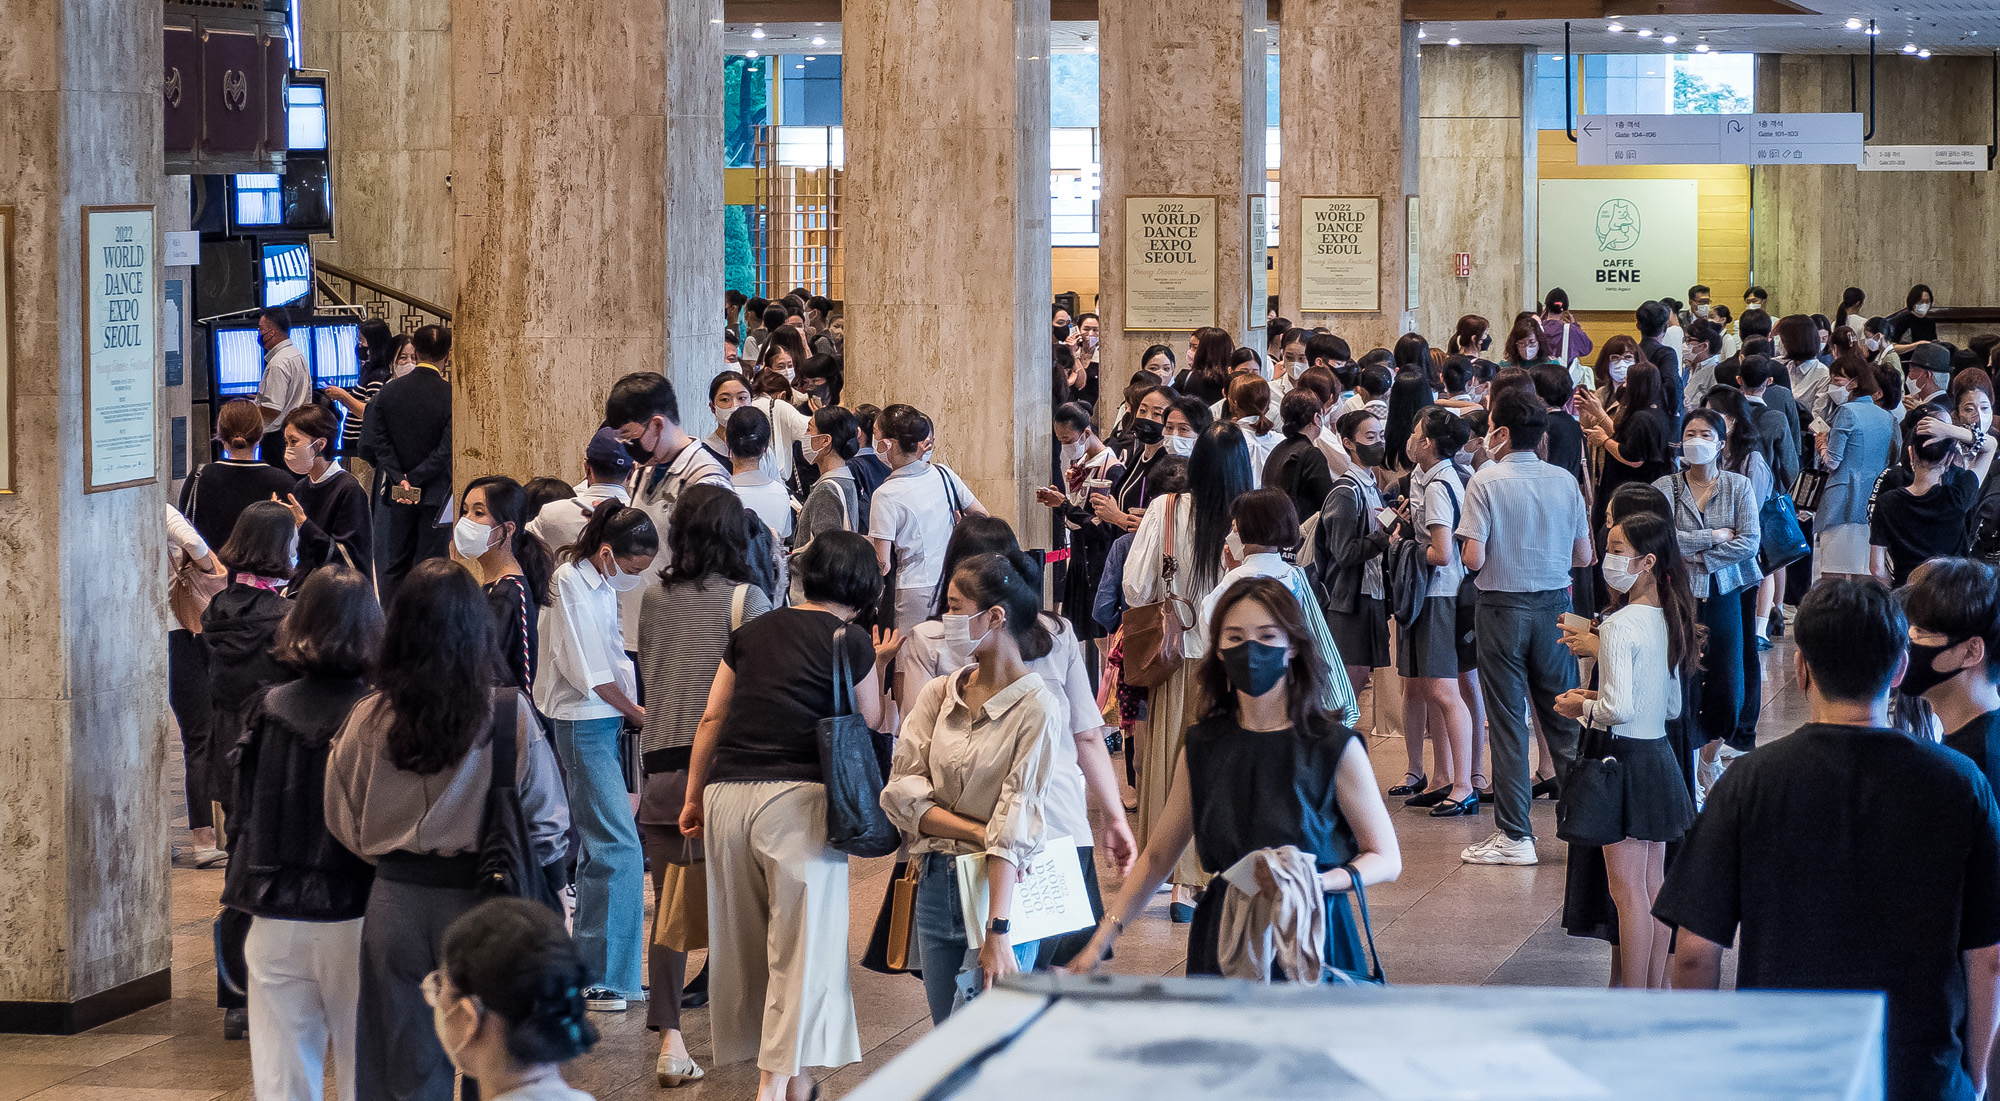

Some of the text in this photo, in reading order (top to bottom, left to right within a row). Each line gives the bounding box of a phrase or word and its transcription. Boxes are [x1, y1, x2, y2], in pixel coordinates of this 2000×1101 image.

[1615, 121, 1625, 129] 1층
[1758, 120, 1768, 128] 1층
[1158, 204, 1184, 212] 2022
[1328, 203, 1351, 211] 2022
[1141, 213, 1201, 225] WORLD
[1314, 211, 1366, 222] WORLD
[115, 226, 133, 242] 2022
[1144, 226, 1198, 238] DANCE
[1317, 223, 1363, 233] DANCE
[1322, 233, 1358, 244] EXPO
[1150, 239, 1192, 251] EXPO
[1317, 244, 1362, 255] SEOUL
[103, 245, 144, 268] WORLD
[1144, 252, 1197, 264] SEOUL
[1603, 259, 1634, 267] CAFFE
[1595, 269, 1641, 283] BENE
[104, 272, 143, 295] DANCE
[108, 298, 139, 322] EXPO
[103, 324, 142, 349] SEOUL
[1036, 865, 1055, 915] DANCE
[1046, 859, 1065, 914] WORLD
[1059, 872, 1069, 897] 2022
[1026, 872, 1043, 911] EXPO
[1017, 879, 1034, 918] EOUL
